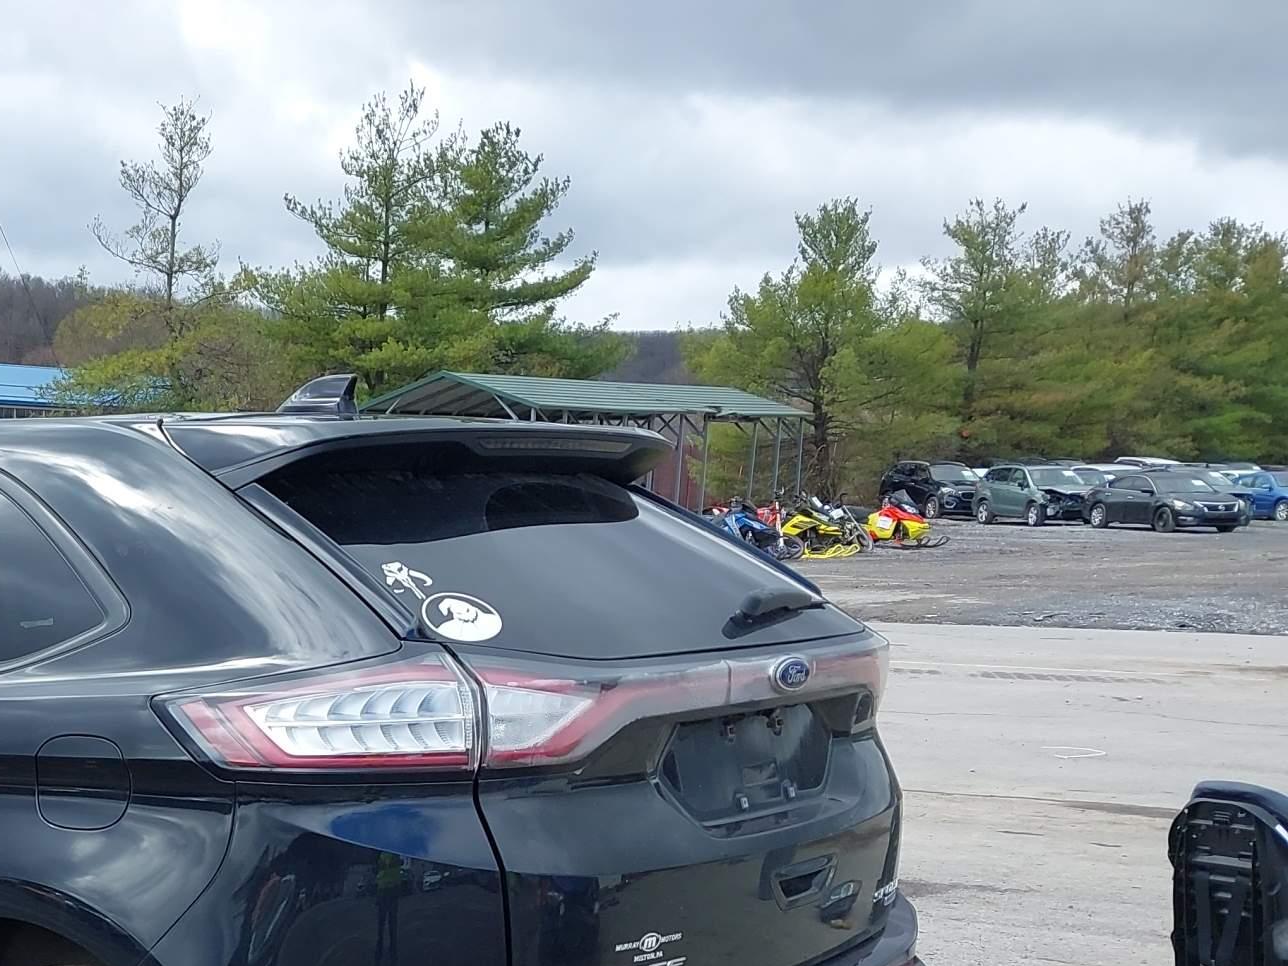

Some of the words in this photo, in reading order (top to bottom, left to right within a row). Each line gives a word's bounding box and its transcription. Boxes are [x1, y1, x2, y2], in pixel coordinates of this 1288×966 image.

[787, 665, 806, 683] Ford
[615, 941, 640, 952] MURRAY
[660, 932, 682, 943] MOTORS
